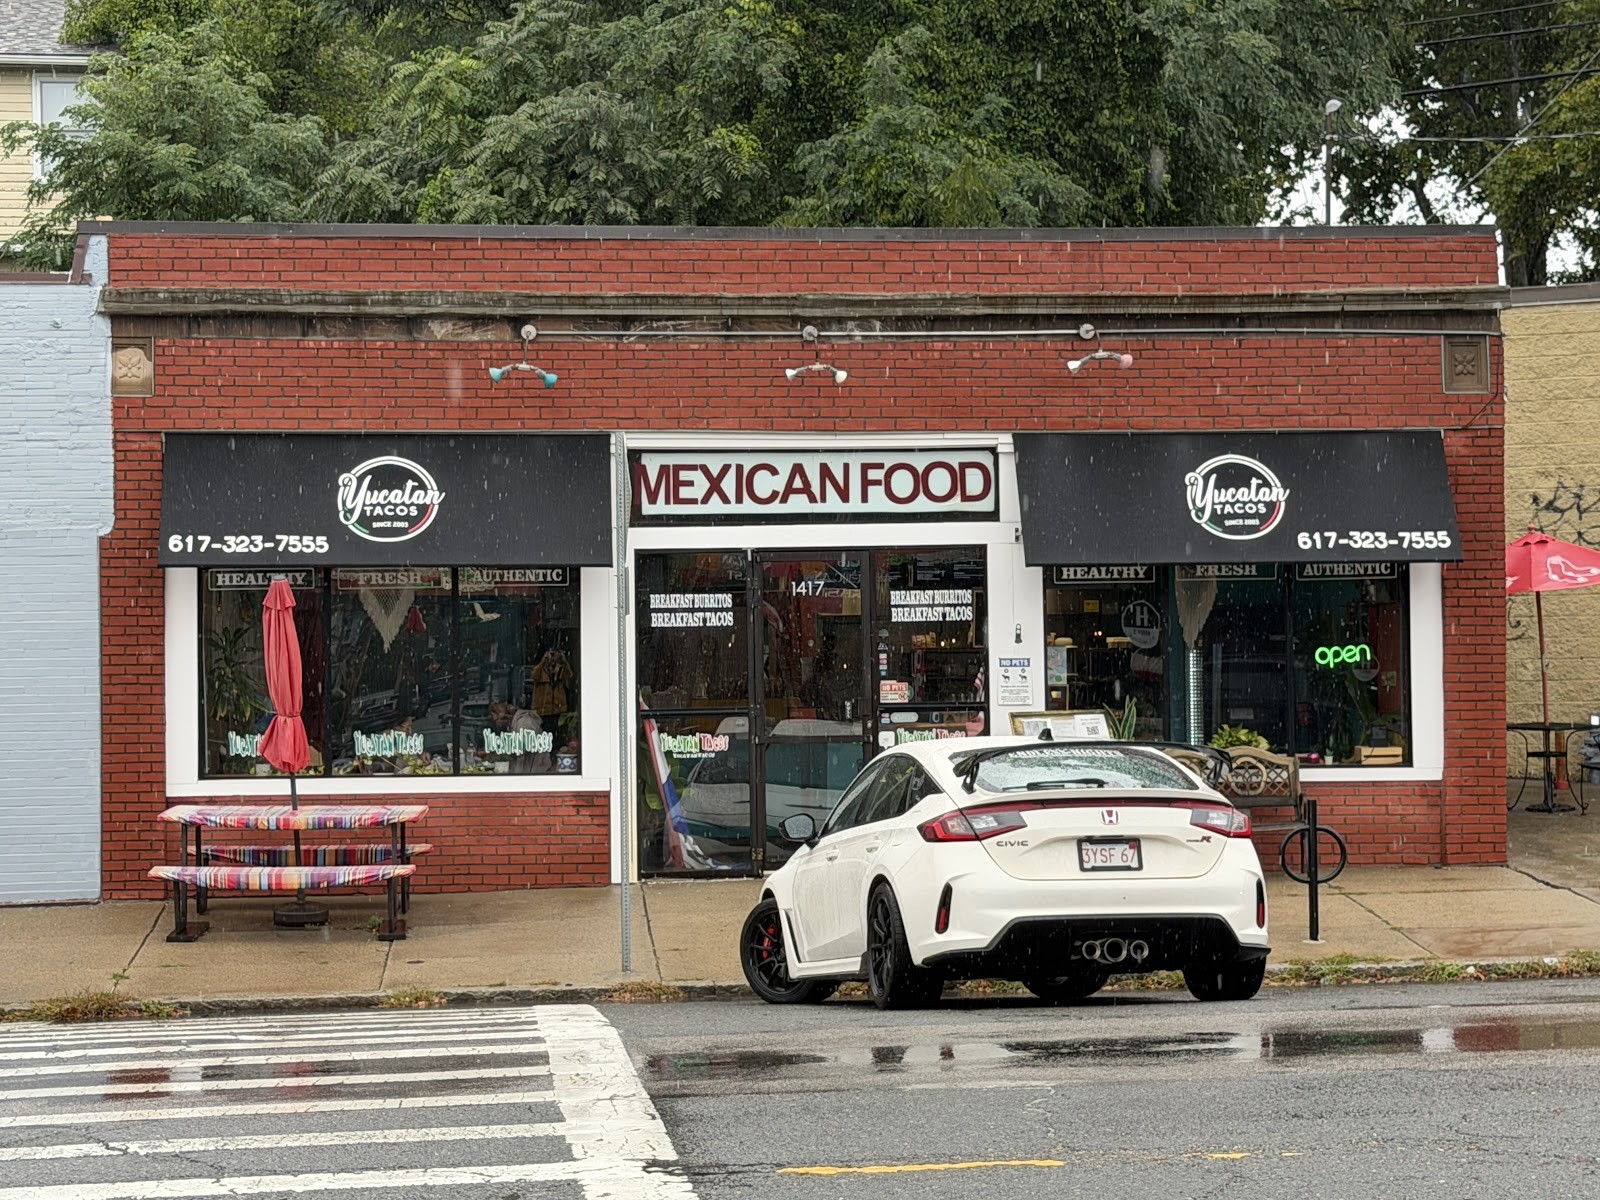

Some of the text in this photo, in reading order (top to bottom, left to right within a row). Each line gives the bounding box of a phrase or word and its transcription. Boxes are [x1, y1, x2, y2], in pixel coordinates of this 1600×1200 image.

[635, 461, 992, 505] MEXICAN FOOD
[338, 473, 446, 525] Yucatan
[1185, 472, 1290, 523] Yucatan
[363, 505, 418, 516] TACOS
[1213, 503, 1267, 515] TACOS
[1224, 519, 1243, 527] SINCE
[168, 534, 330, 555] 617-323-7555
[1297, 530, 1452, 550] 617-323-7555
[473, 568, 563, 582] AUTHENTIC
[1061, 566, 1149, 580] HEALTHY
[1195, 564, 1258, 577] FRESH
[1303, 562, 1391, 576] AUTHENTIC
[357, 572, 423, 585] FRESH
[791, 580, 825, 597] 1417
[649, 593, 733, 609] BREAKFAST BURRITOS
[890, 589, 972, 605] BREAKFAST BURRITOS
[650, 611, 734, 627] BREAKFAST TACOS
[891, 606, 973, 622] BREAKFAST TACOS
[1314, 643, 1371, 668] open
[660, 732, 729, 753] YUCATAN TACOS
[1082, 847, 1136, 864] 3YSF 67
